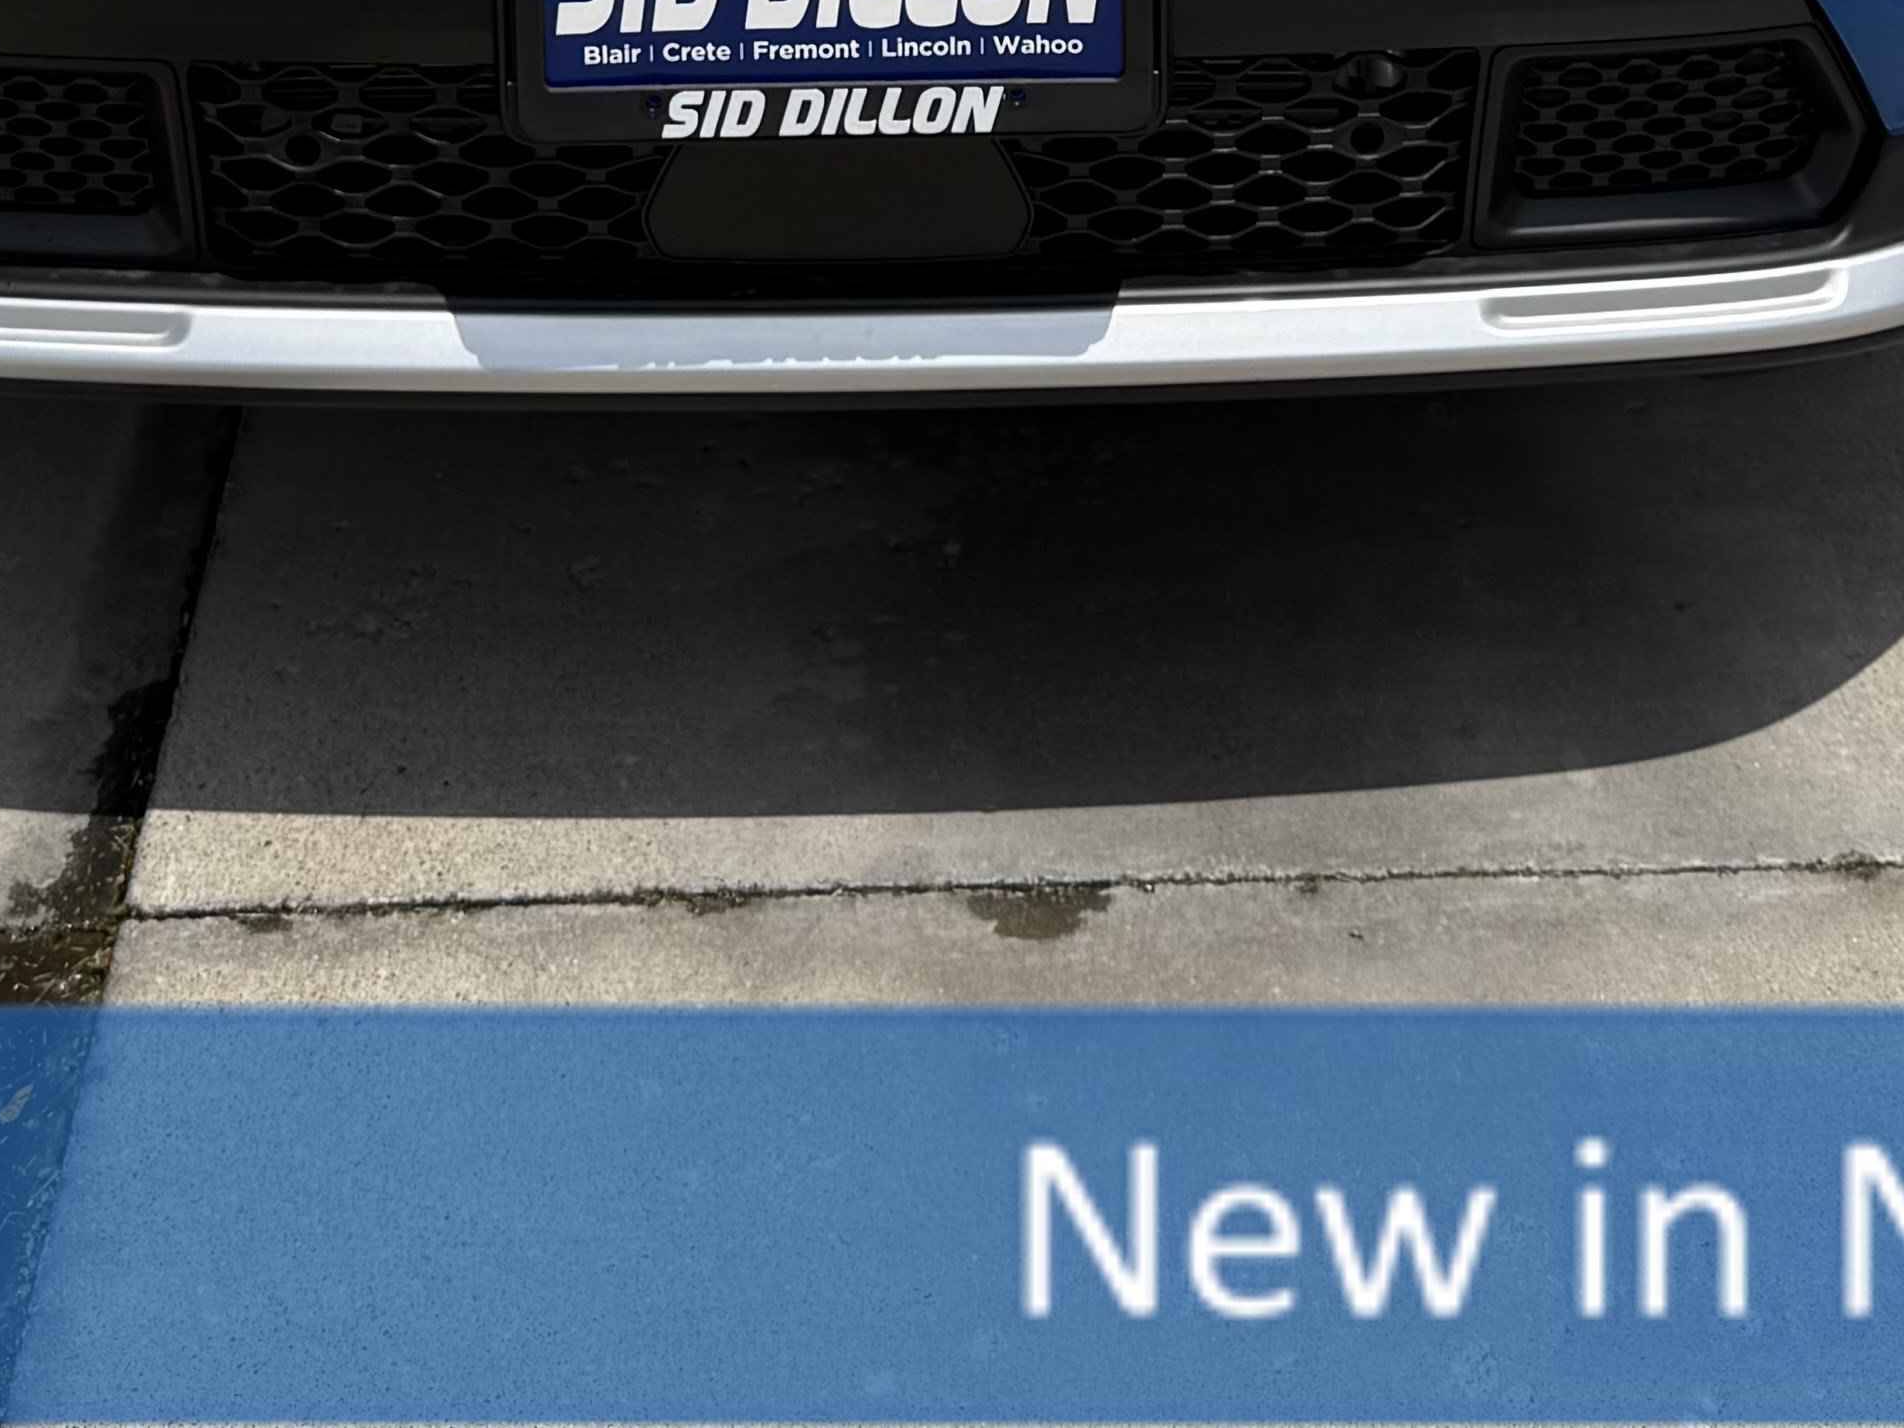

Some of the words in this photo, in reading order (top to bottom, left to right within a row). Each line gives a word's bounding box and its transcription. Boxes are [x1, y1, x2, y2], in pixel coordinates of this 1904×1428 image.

[583, 43, 642, 66] Blair
[662, 42, 732, 62] Crete
[753, 39, 860, 61] Fremont
[881, 35, 972, 58] Lincoln
[992, 34, 1084, 55] Wahoo
[661, 89, 766, 139] SID
[778, 85, 1005, 137] DILLON
